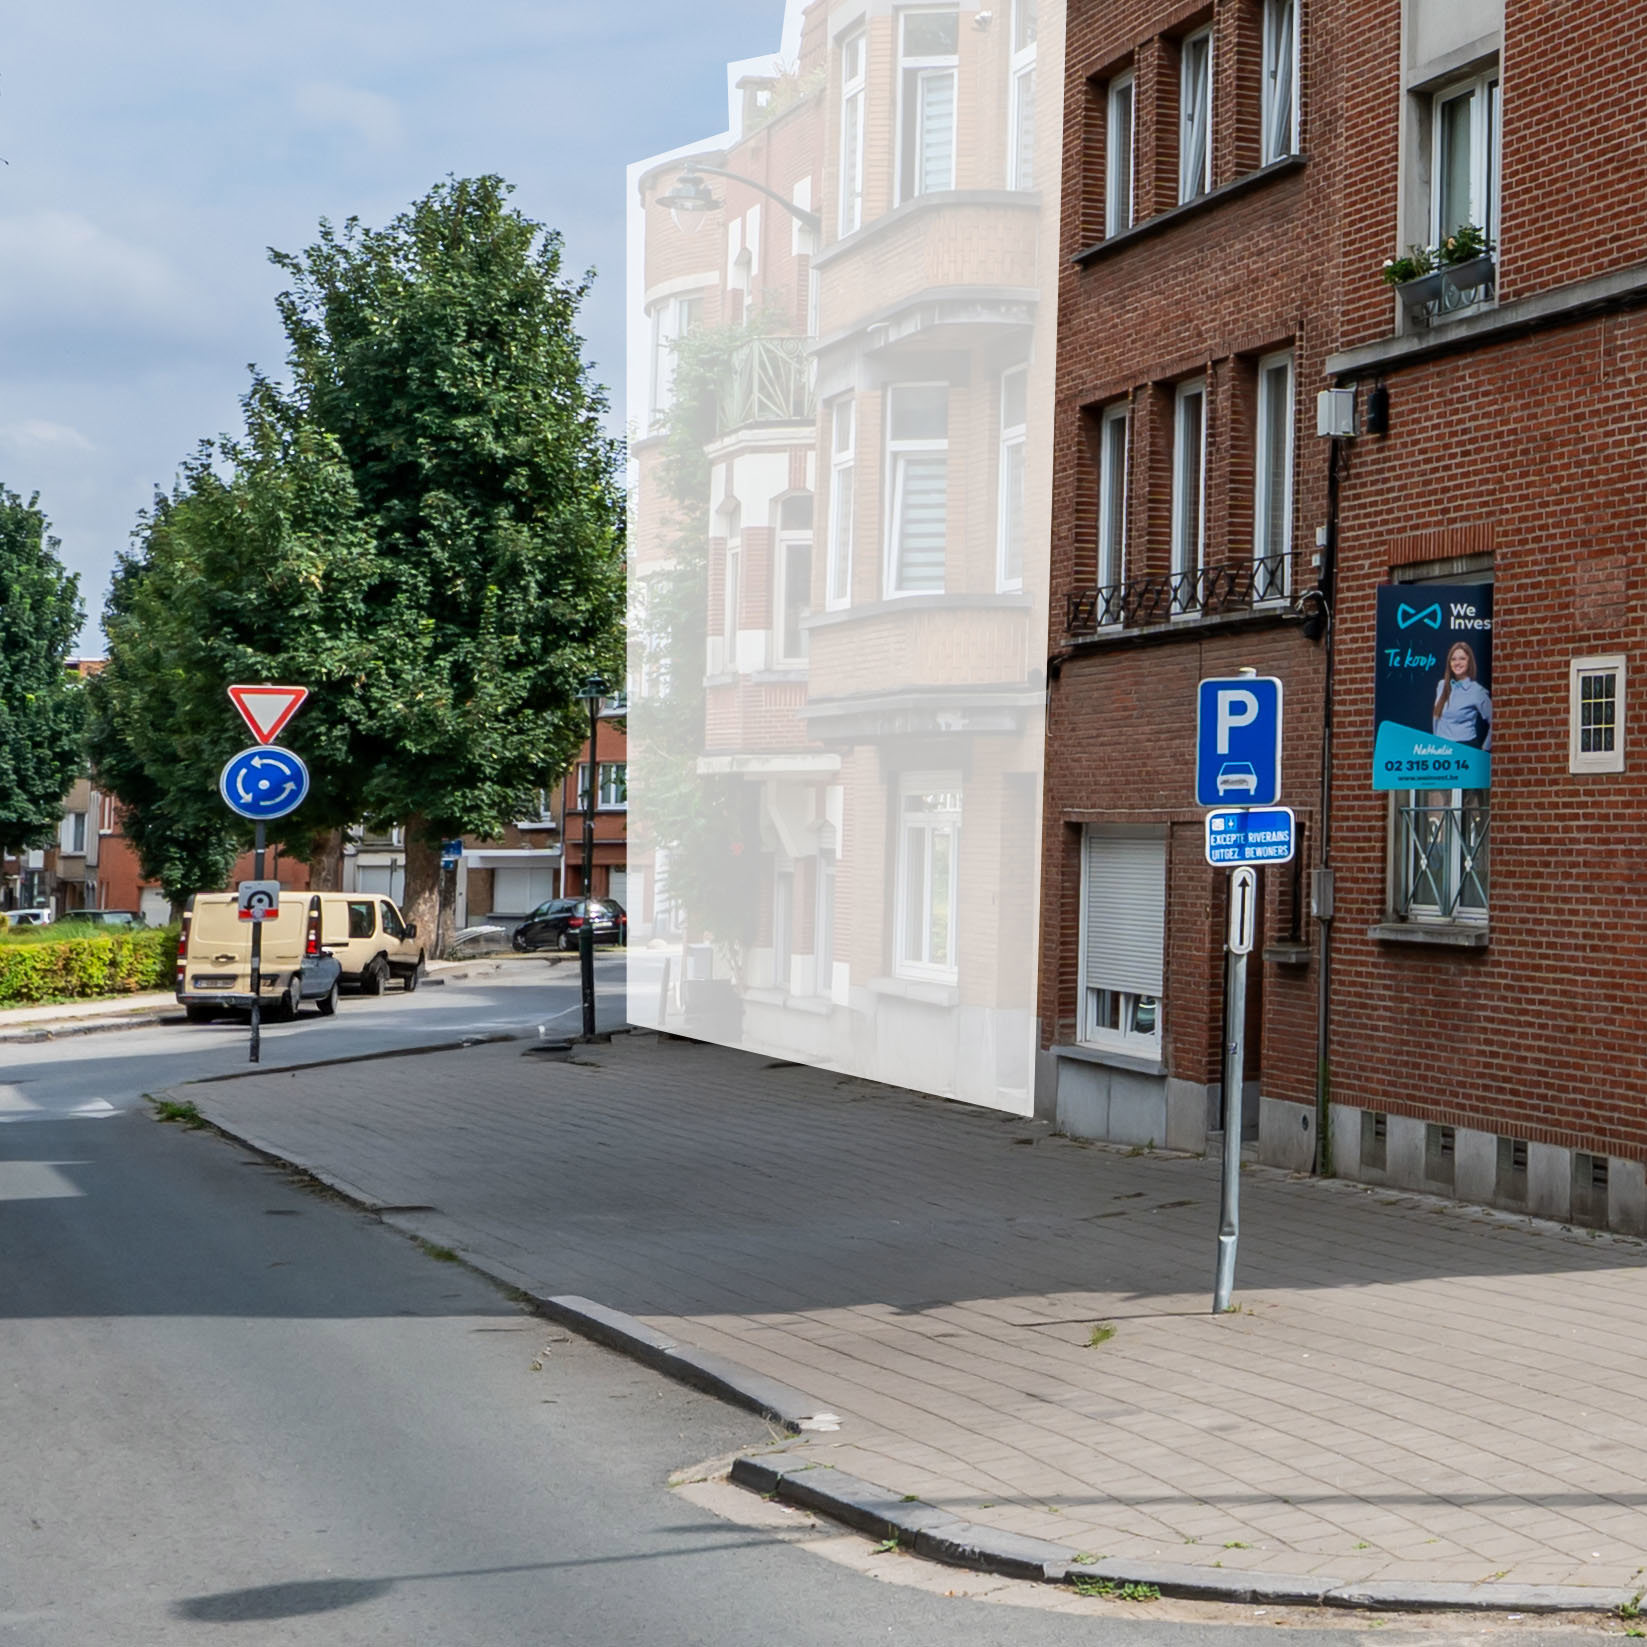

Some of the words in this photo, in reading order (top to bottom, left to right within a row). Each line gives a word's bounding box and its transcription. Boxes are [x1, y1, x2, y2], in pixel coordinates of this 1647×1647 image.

[1449, 603, 1477, 617] We
[1450, 616, 1492, 630] Inves
[1384, 648, 1401, 667] Te
[1404, 648, 1436, 671] koop
[1217, 689, 1259, 754] P
[1413, 743, 1453, 755] Nathalie
[1384, 760, 1403, 772] 02
[1406, 760, 1429, 772] 315
[1432, 759, 1451, 771] 00
[1454, 759, 1470, 771] 14
[1247, 830, 1289, 844] RIVERAINS
[1244, 845, 1289, 859] BEWONERS
